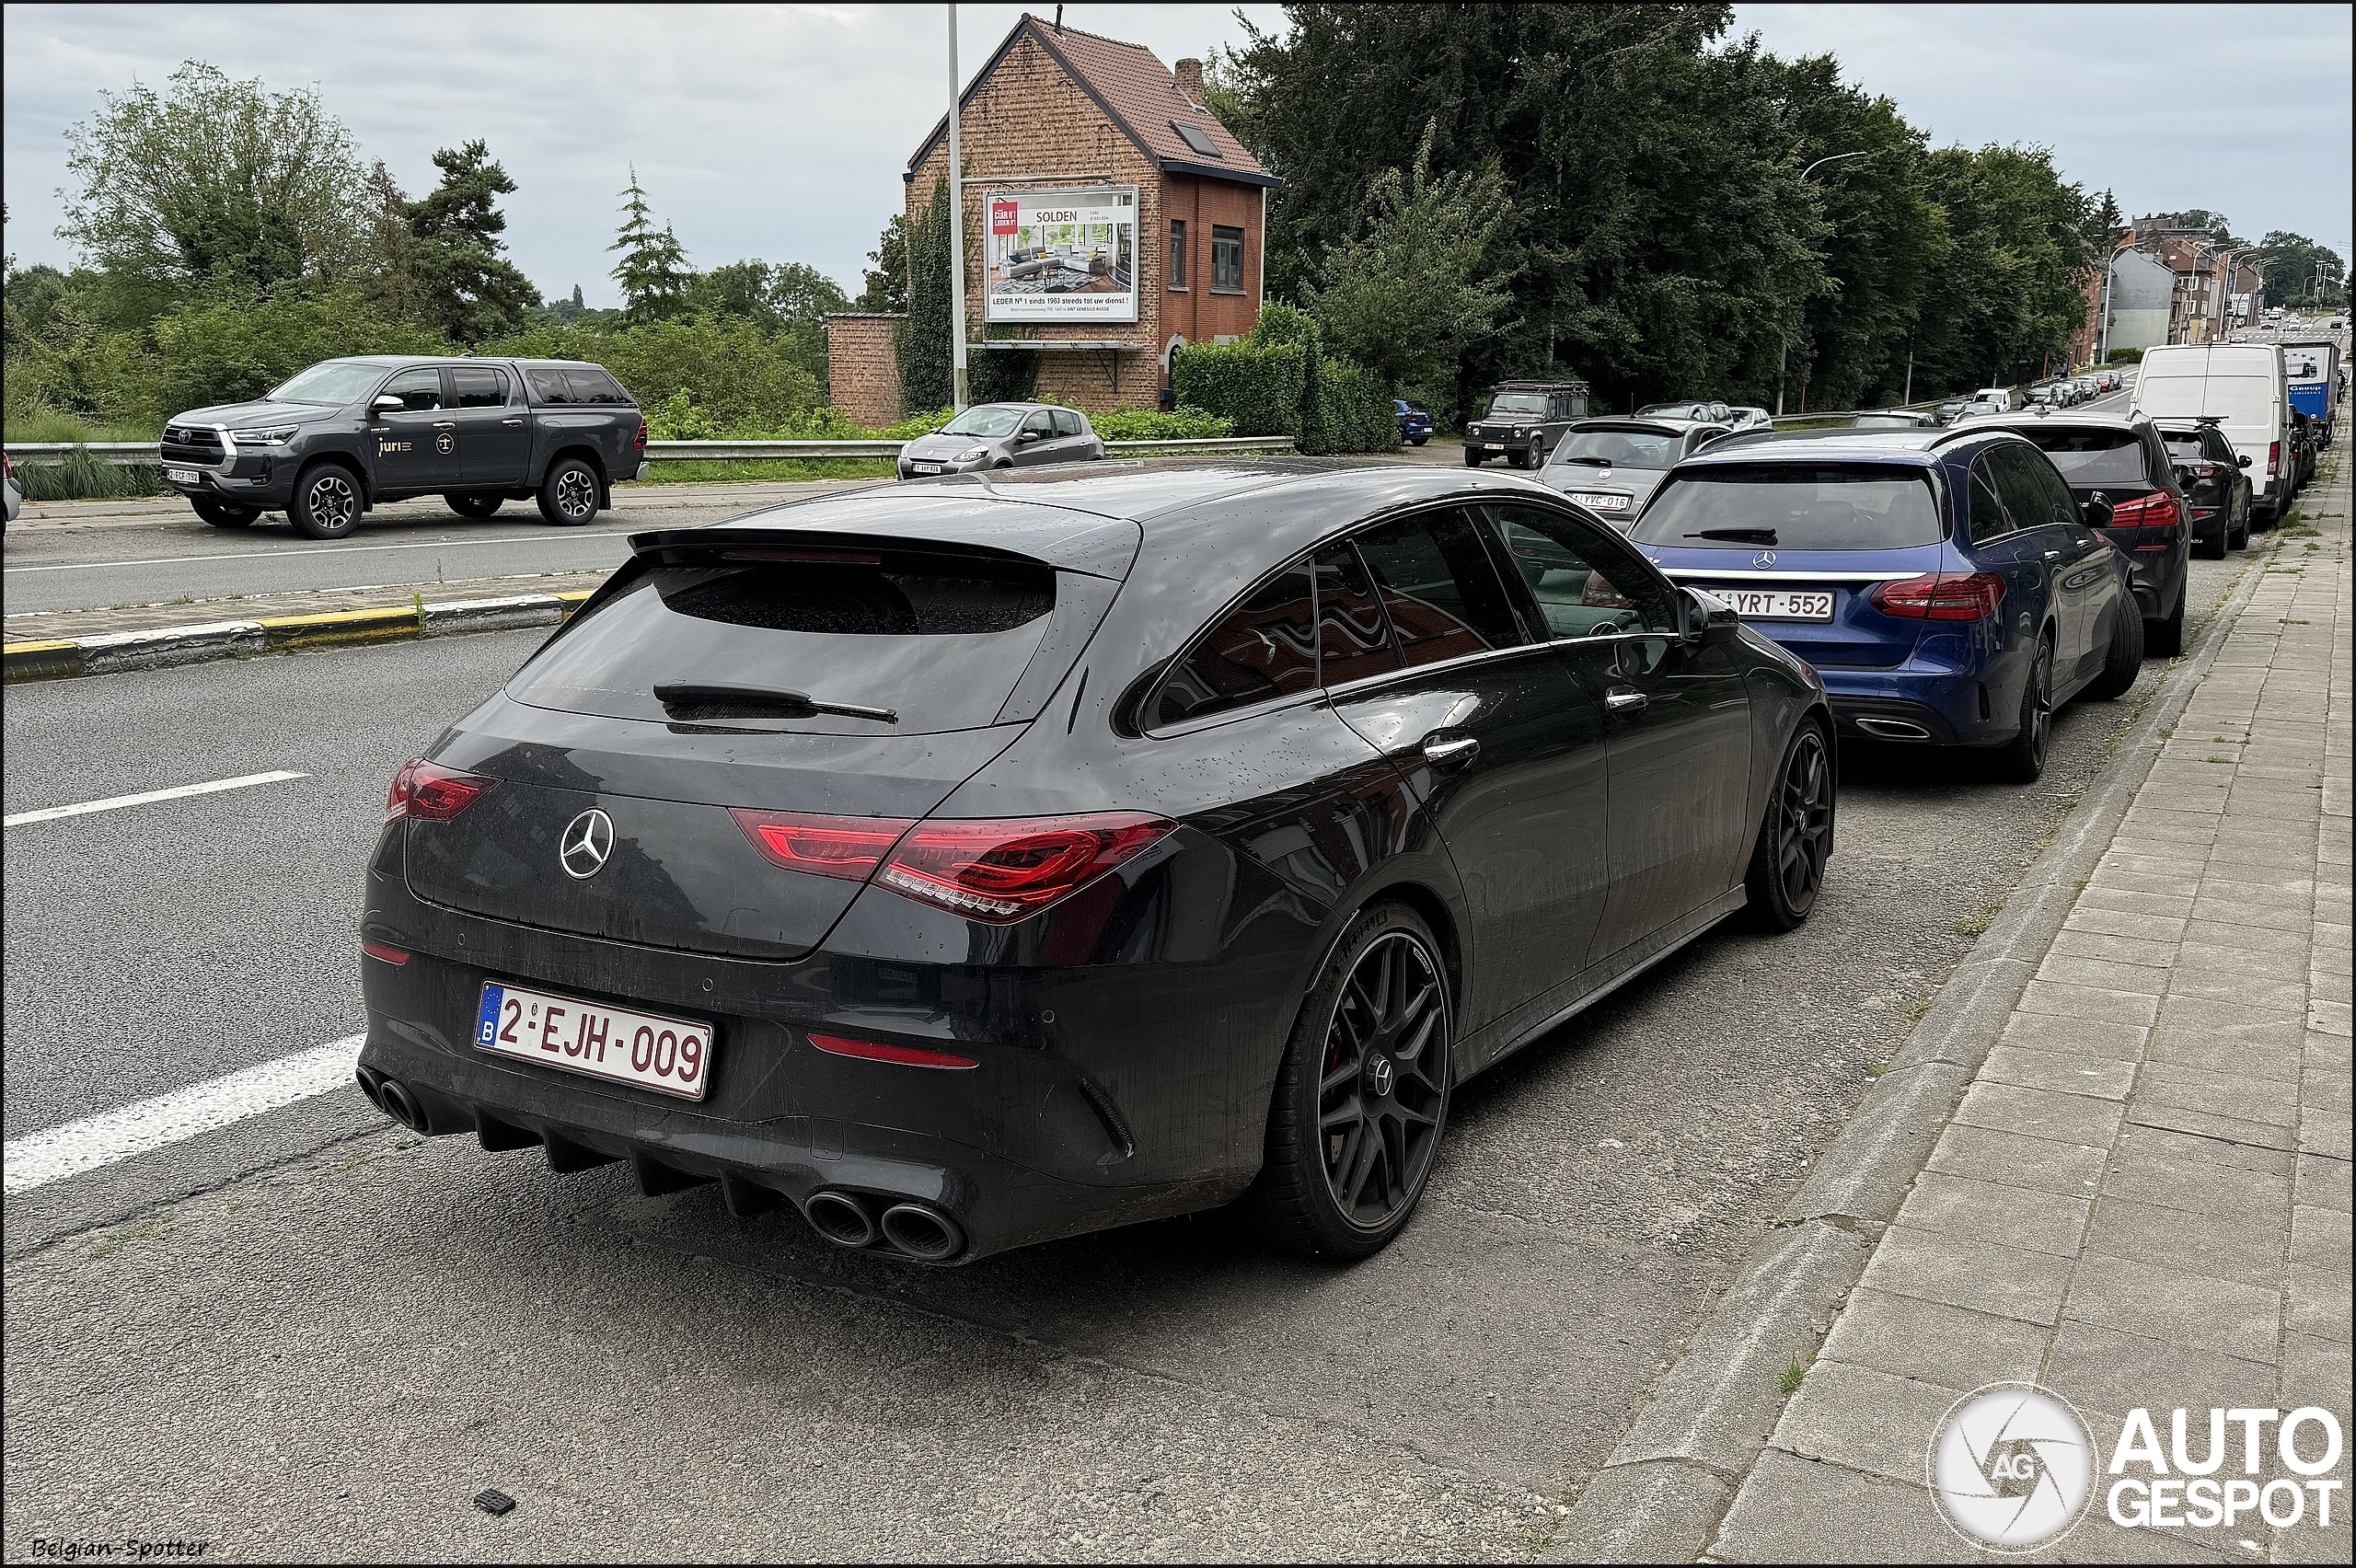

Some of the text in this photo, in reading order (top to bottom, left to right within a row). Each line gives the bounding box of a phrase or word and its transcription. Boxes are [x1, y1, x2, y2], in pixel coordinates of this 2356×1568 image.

[1036, 211, 1077, 223] SOLDEN
[992, 297, 1013, 306] LEDER
[1576, 495, 1626, 507] -YVC-016
[481, 998, 702, 1082] B 2-EJH-009
